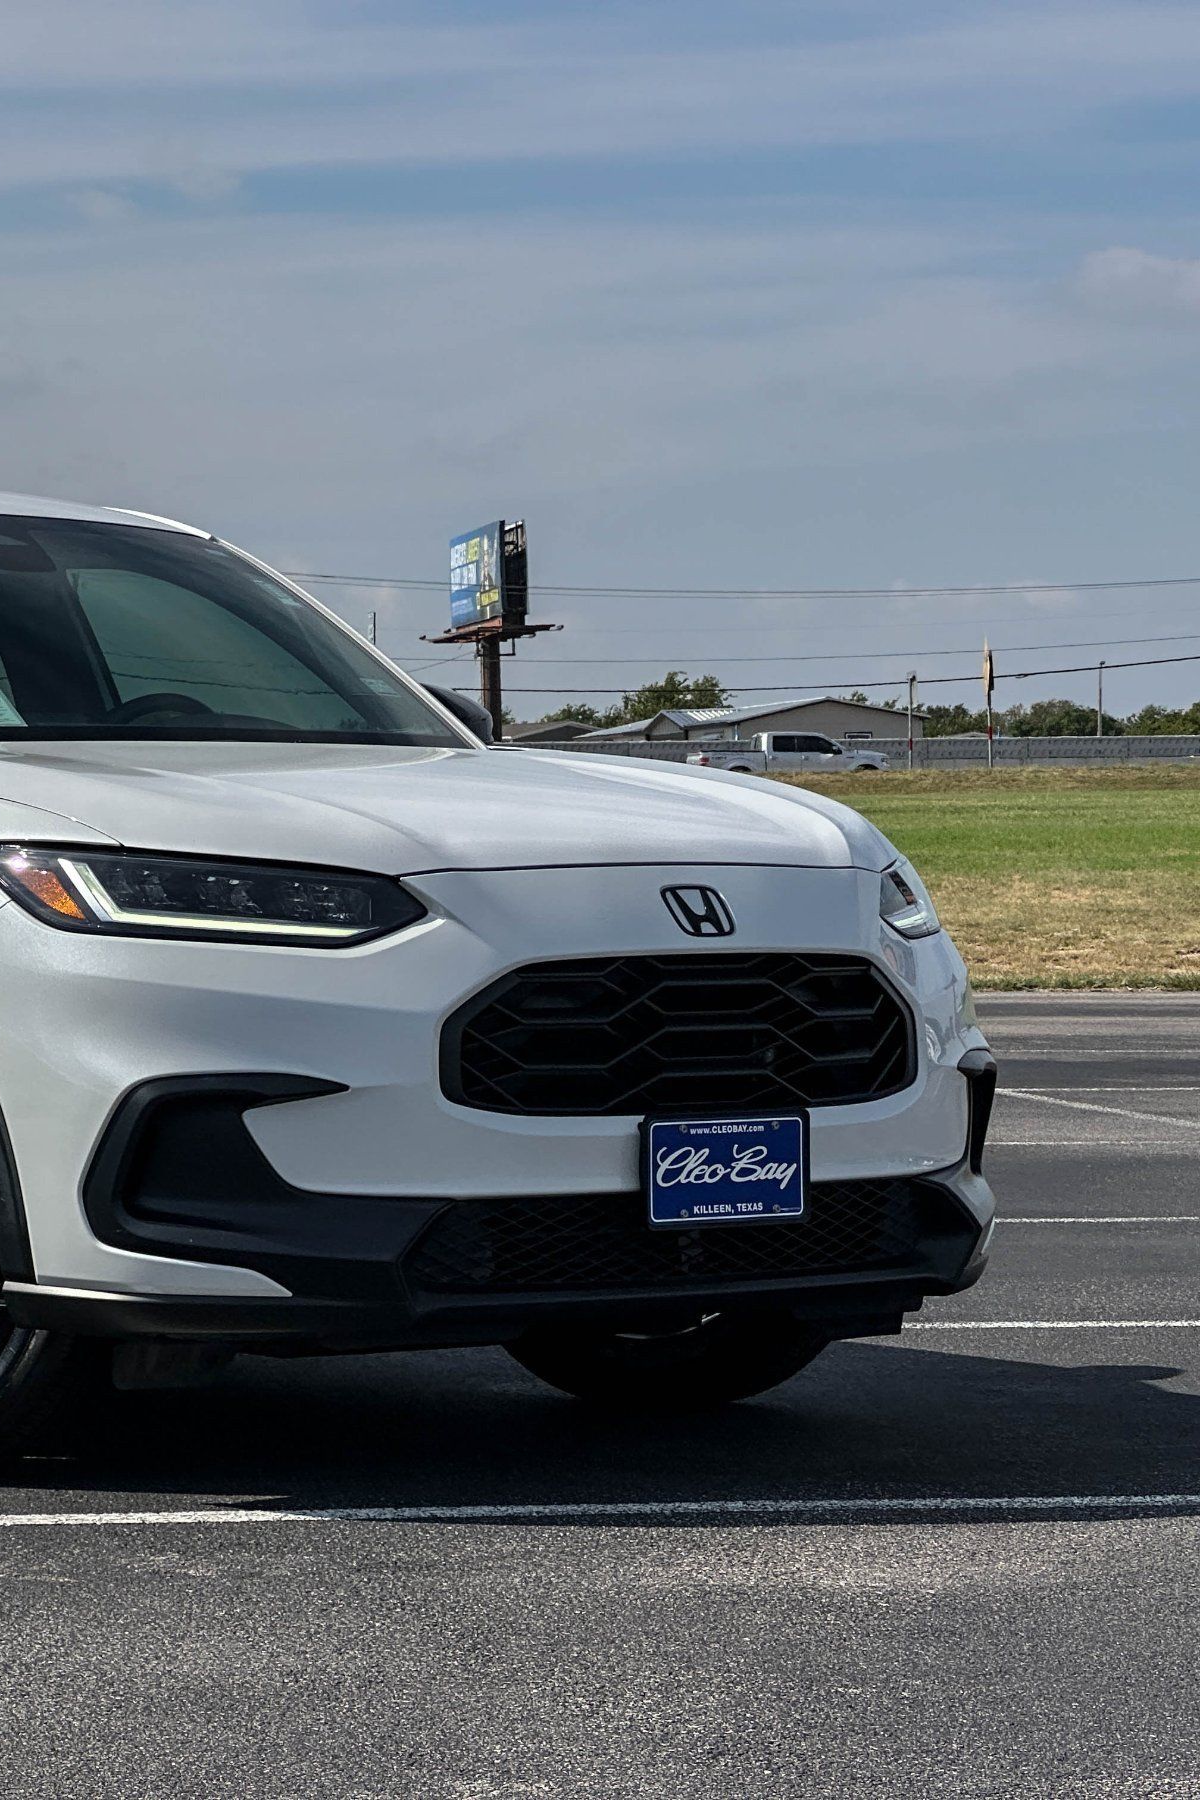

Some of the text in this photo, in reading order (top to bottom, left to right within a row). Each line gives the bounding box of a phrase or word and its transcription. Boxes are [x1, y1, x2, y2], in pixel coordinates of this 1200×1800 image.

[689, 1124, 765, 1135] www.CLEOBAY.com
[656, 1144, 797, 1190] Cleo Bay
[693, 1202, 763, 1215] KILLEEN, TEXAS
